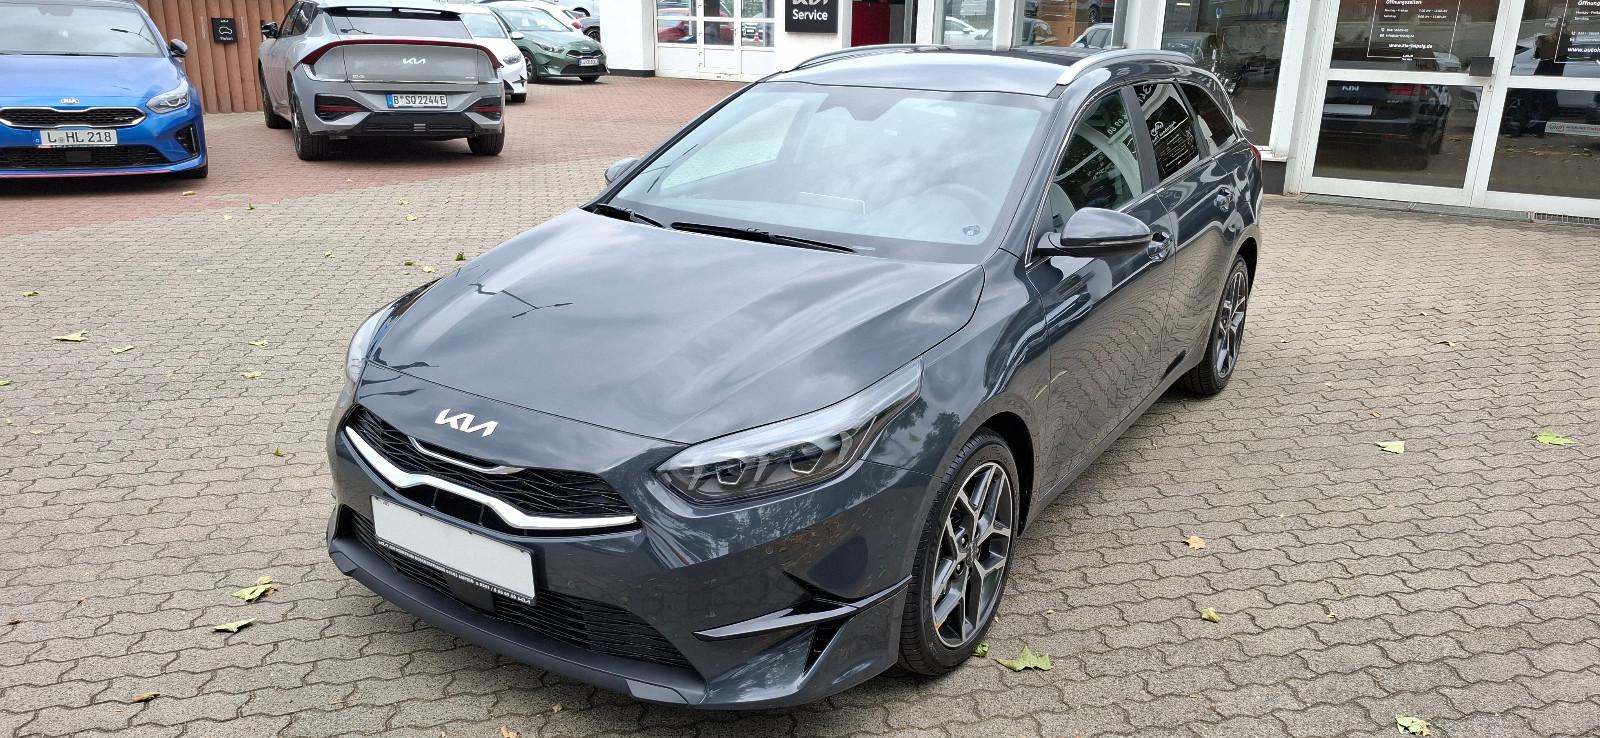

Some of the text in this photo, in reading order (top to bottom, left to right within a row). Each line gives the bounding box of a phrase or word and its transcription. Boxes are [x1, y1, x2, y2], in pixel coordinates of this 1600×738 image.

[792, 9, 828, 21] Service
[393, 95, 399, 105] B
[405, 95, 417, 106] SQ
[47, 131, 112, 143] L HL 218
[434, 408, 499, 437] KIA
